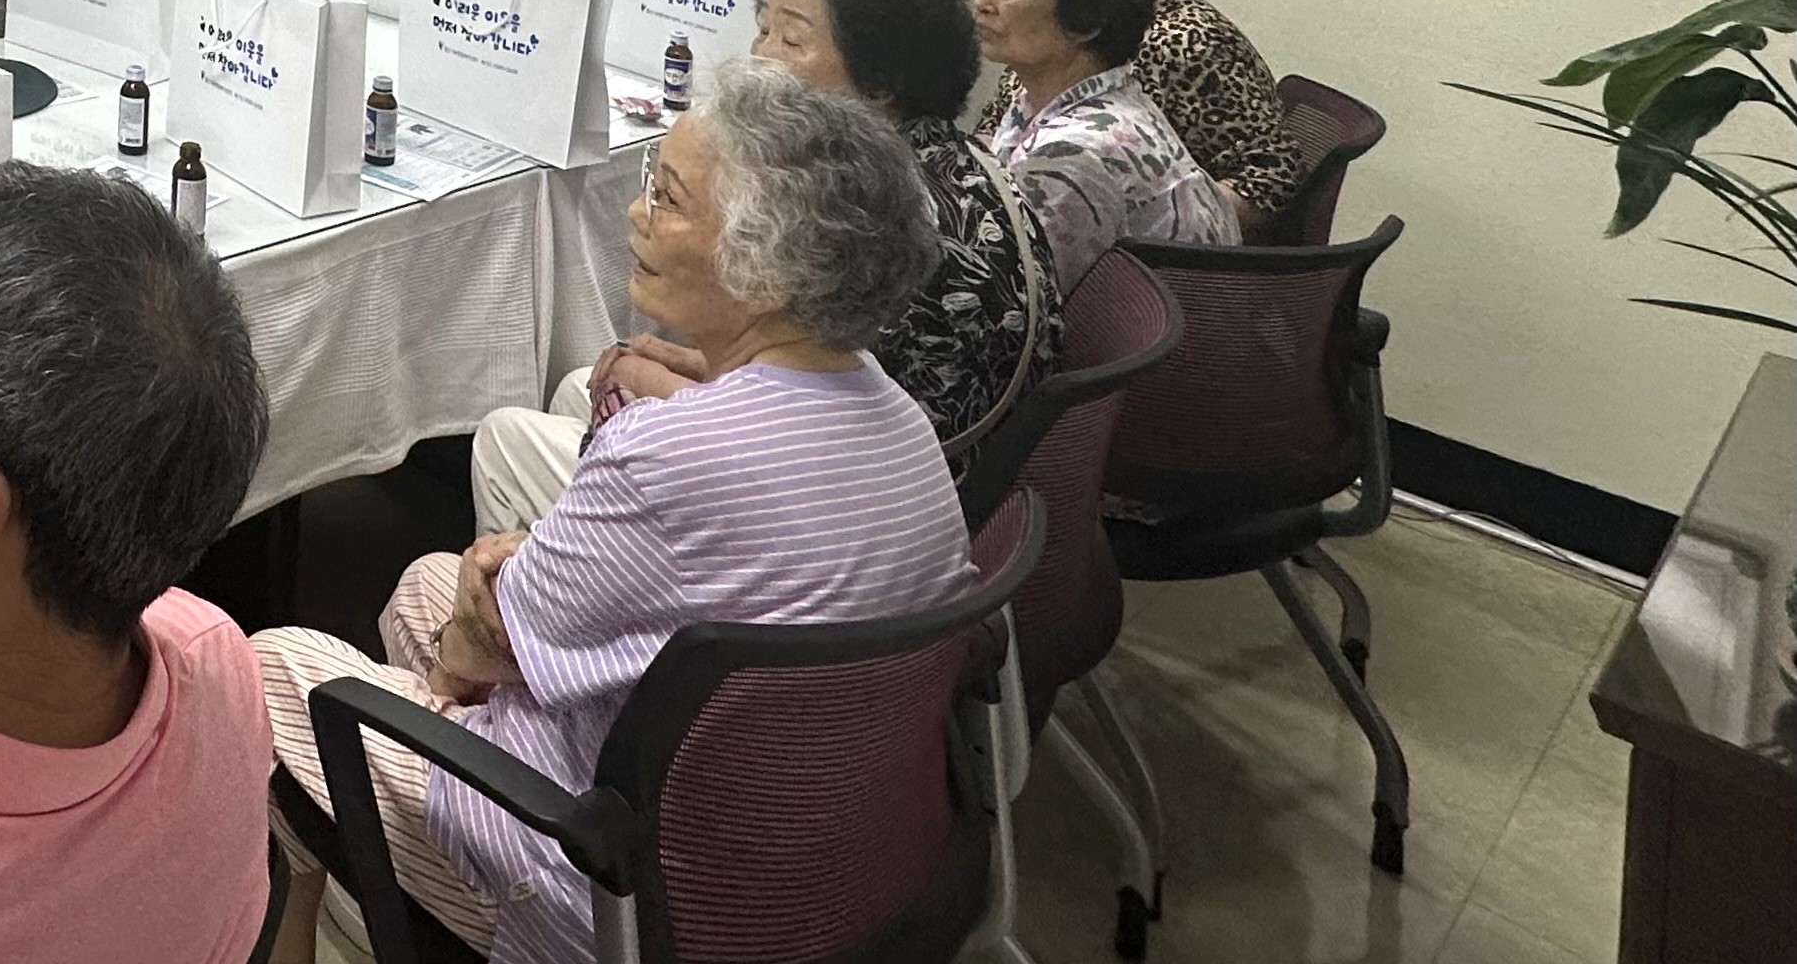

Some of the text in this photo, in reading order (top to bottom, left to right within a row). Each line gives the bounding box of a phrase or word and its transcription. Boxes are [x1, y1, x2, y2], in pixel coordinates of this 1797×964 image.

[236, 39, 264, 65] 이웃을
[433, 16, 532, 55] 먼저 찾아갑니다
[218, 52, 273, 90] 찾아갑니다
